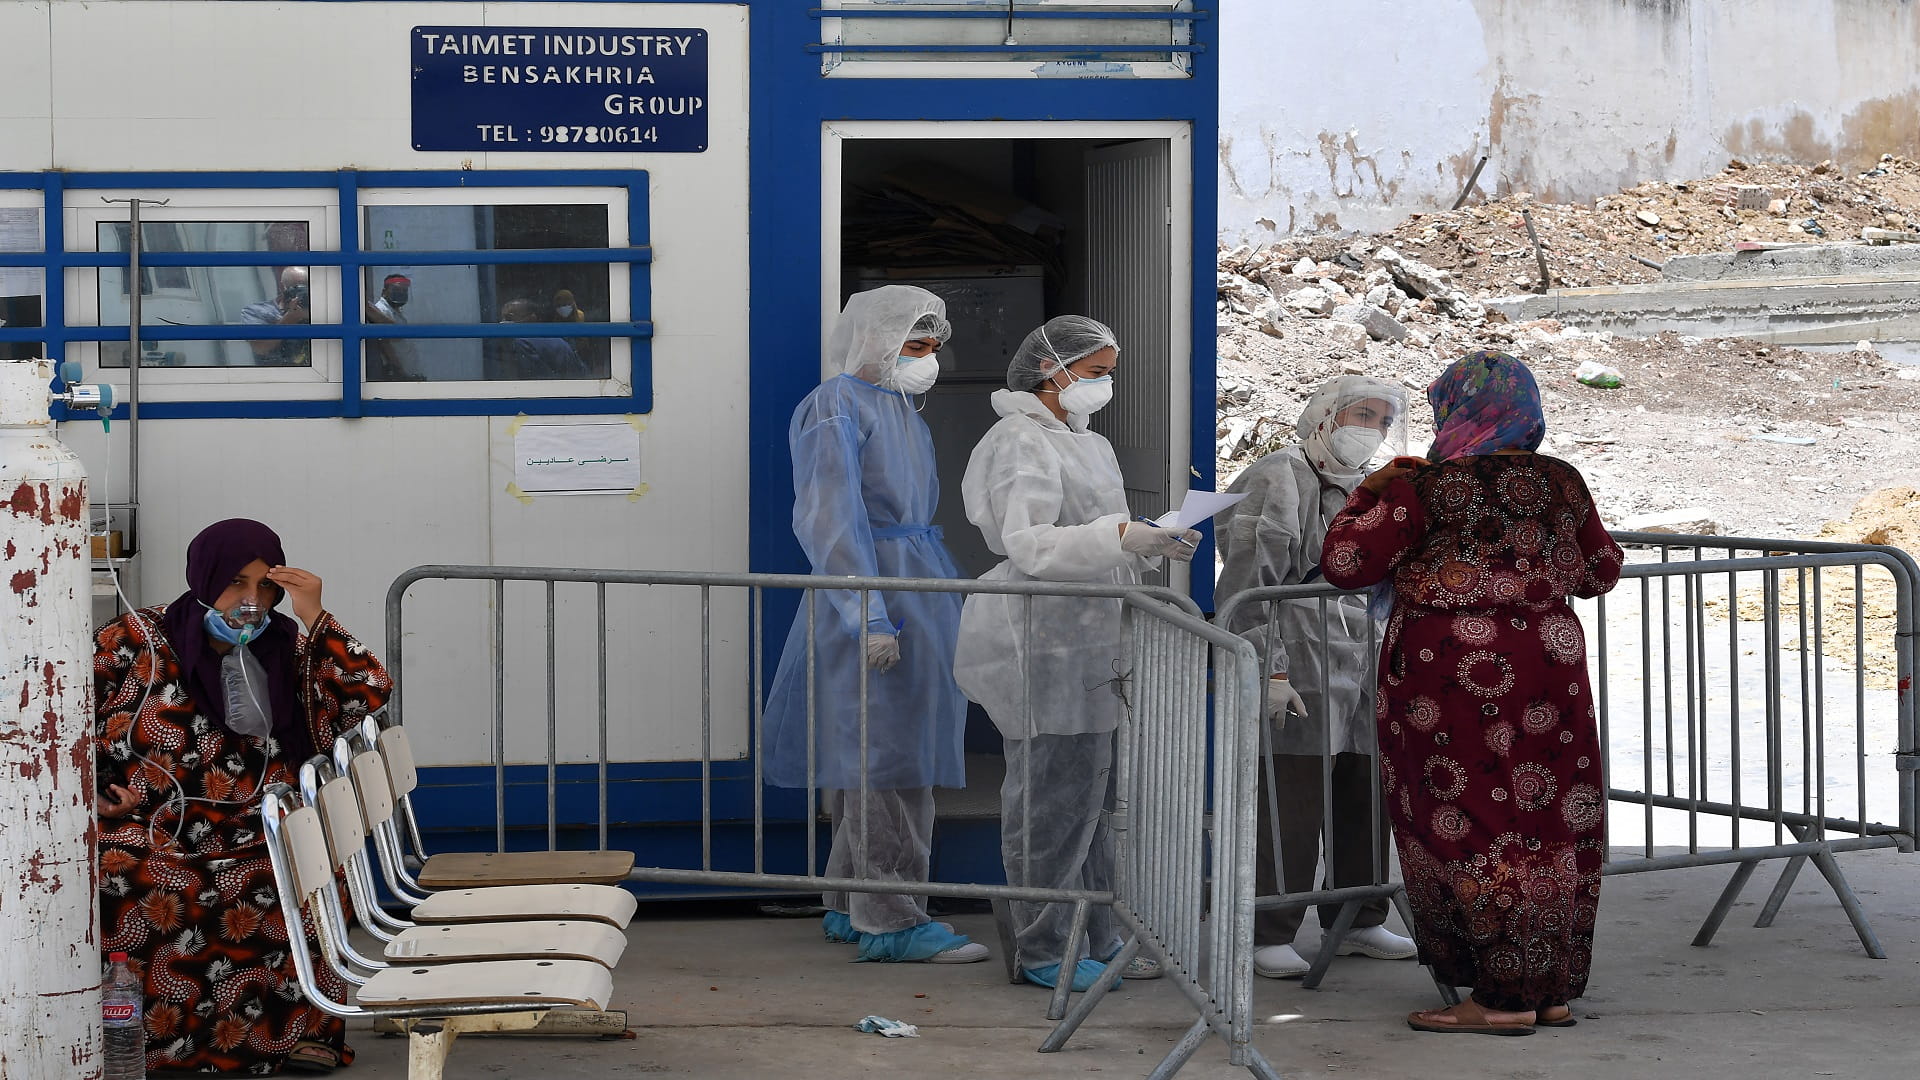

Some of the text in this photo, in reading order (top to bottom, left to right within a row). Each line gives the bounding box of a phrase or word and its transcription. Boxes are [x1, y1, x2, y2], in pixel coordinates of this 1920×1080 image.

[421, 34, 692, 56] TAIMET INDUSTRY
[463, 65, 655, 85] BENSAKHRIA
[604, 93, 703, 115] GROUP
[476, 124, 519, 142] TEL
[540, 125, 658, 144] 98780614
[526, 456, 575, 466] عاديين
